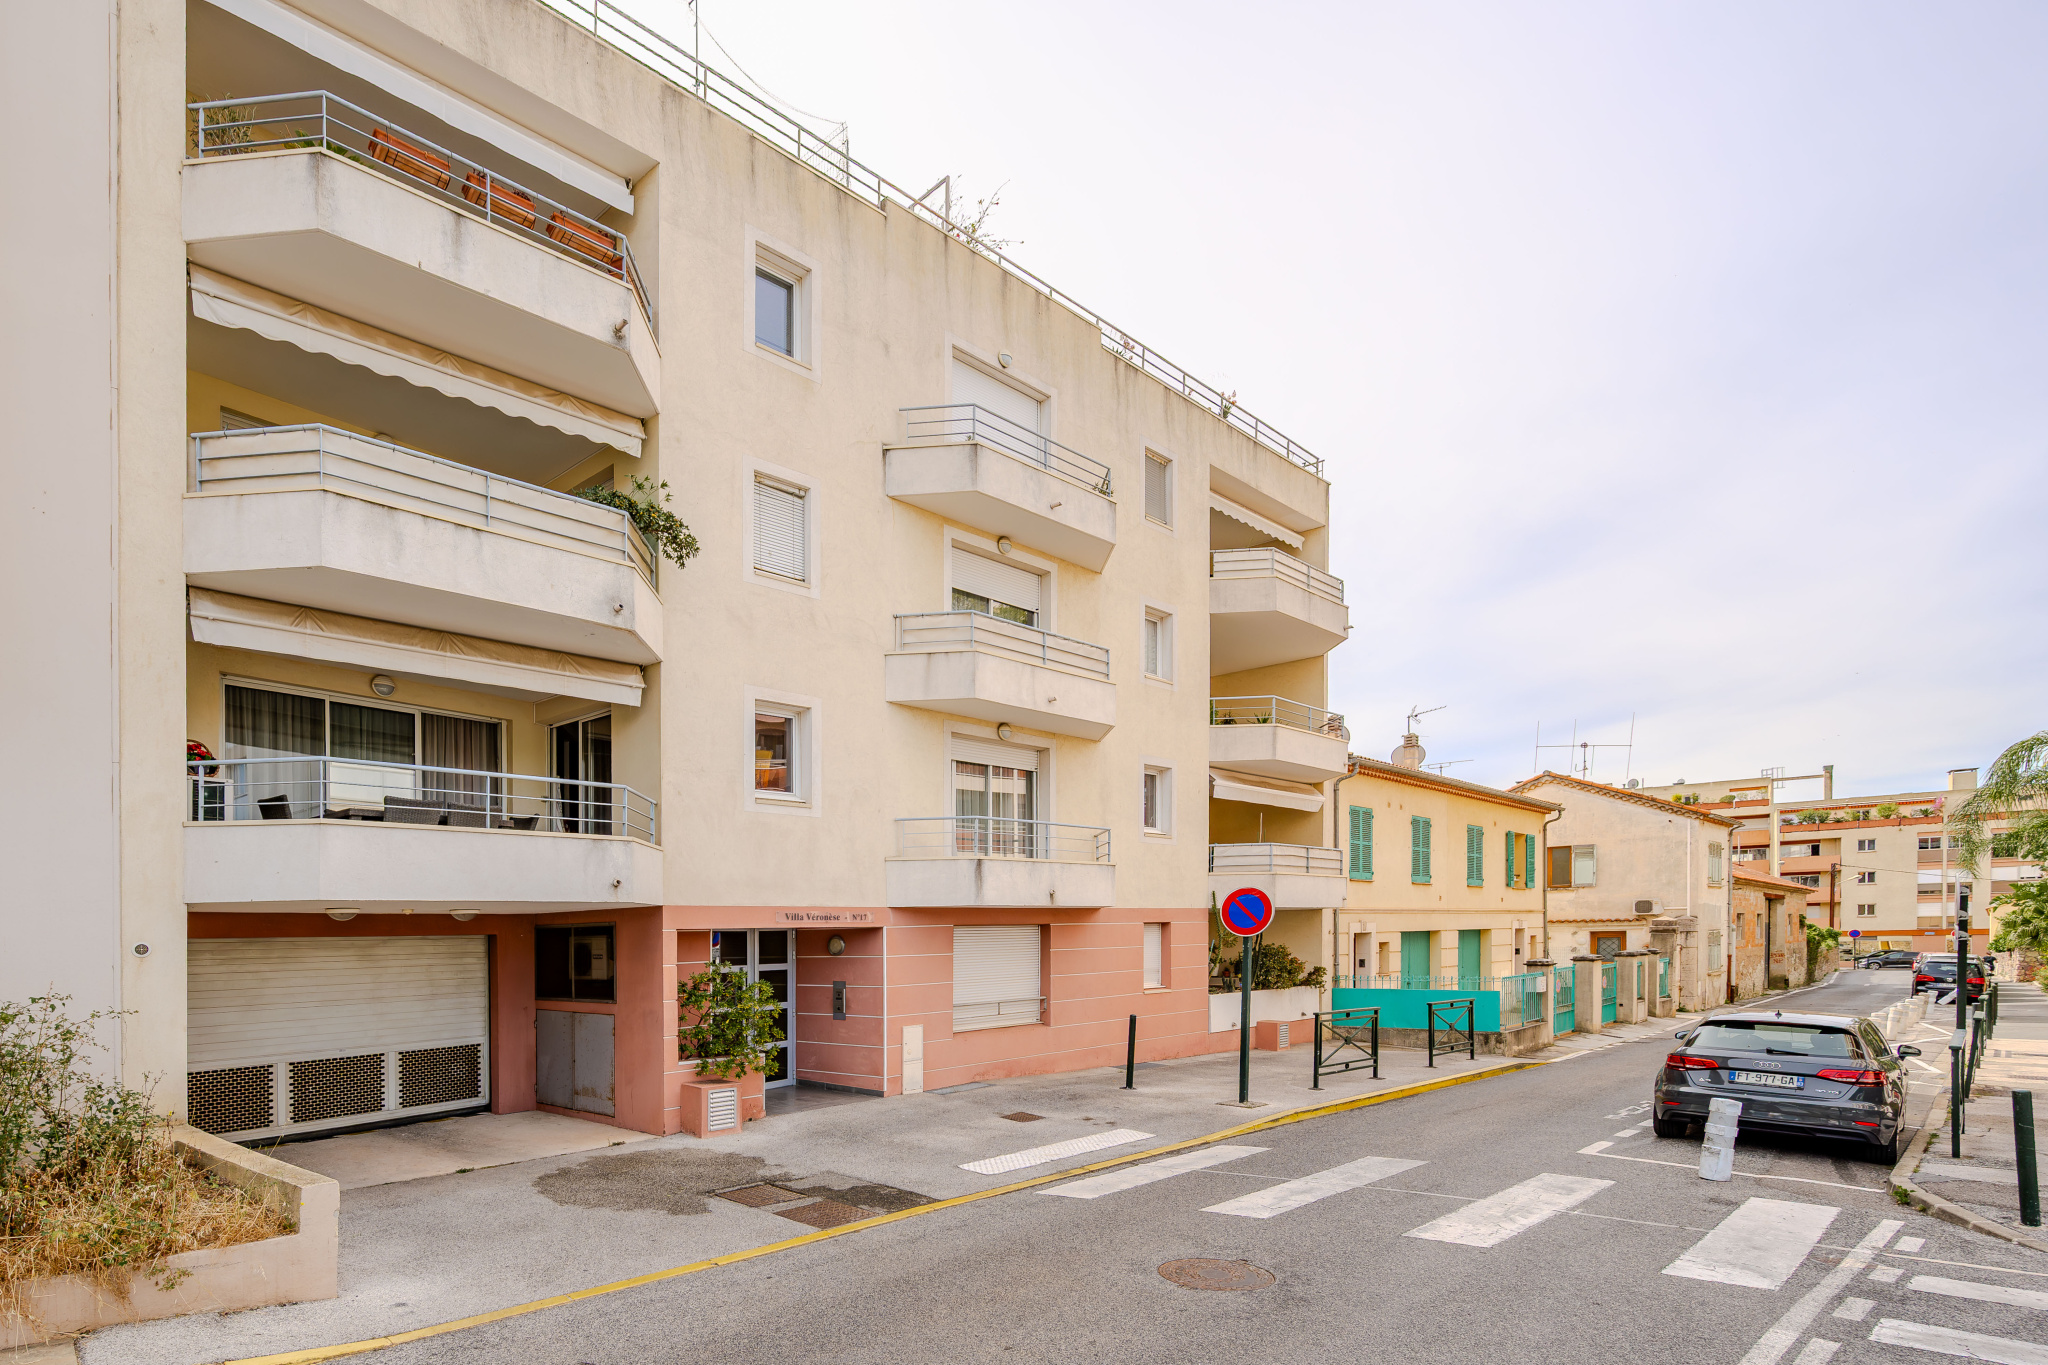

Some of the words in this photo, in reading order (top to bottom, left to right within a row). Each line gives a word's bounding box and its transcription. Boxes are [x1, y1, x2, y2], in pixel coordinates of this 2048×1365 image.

[785, 912, 804, 921] Villa
[806, 912, 841, 921] Véronèse
[1736, 1072, 1795, 1086] FT-977-GA
